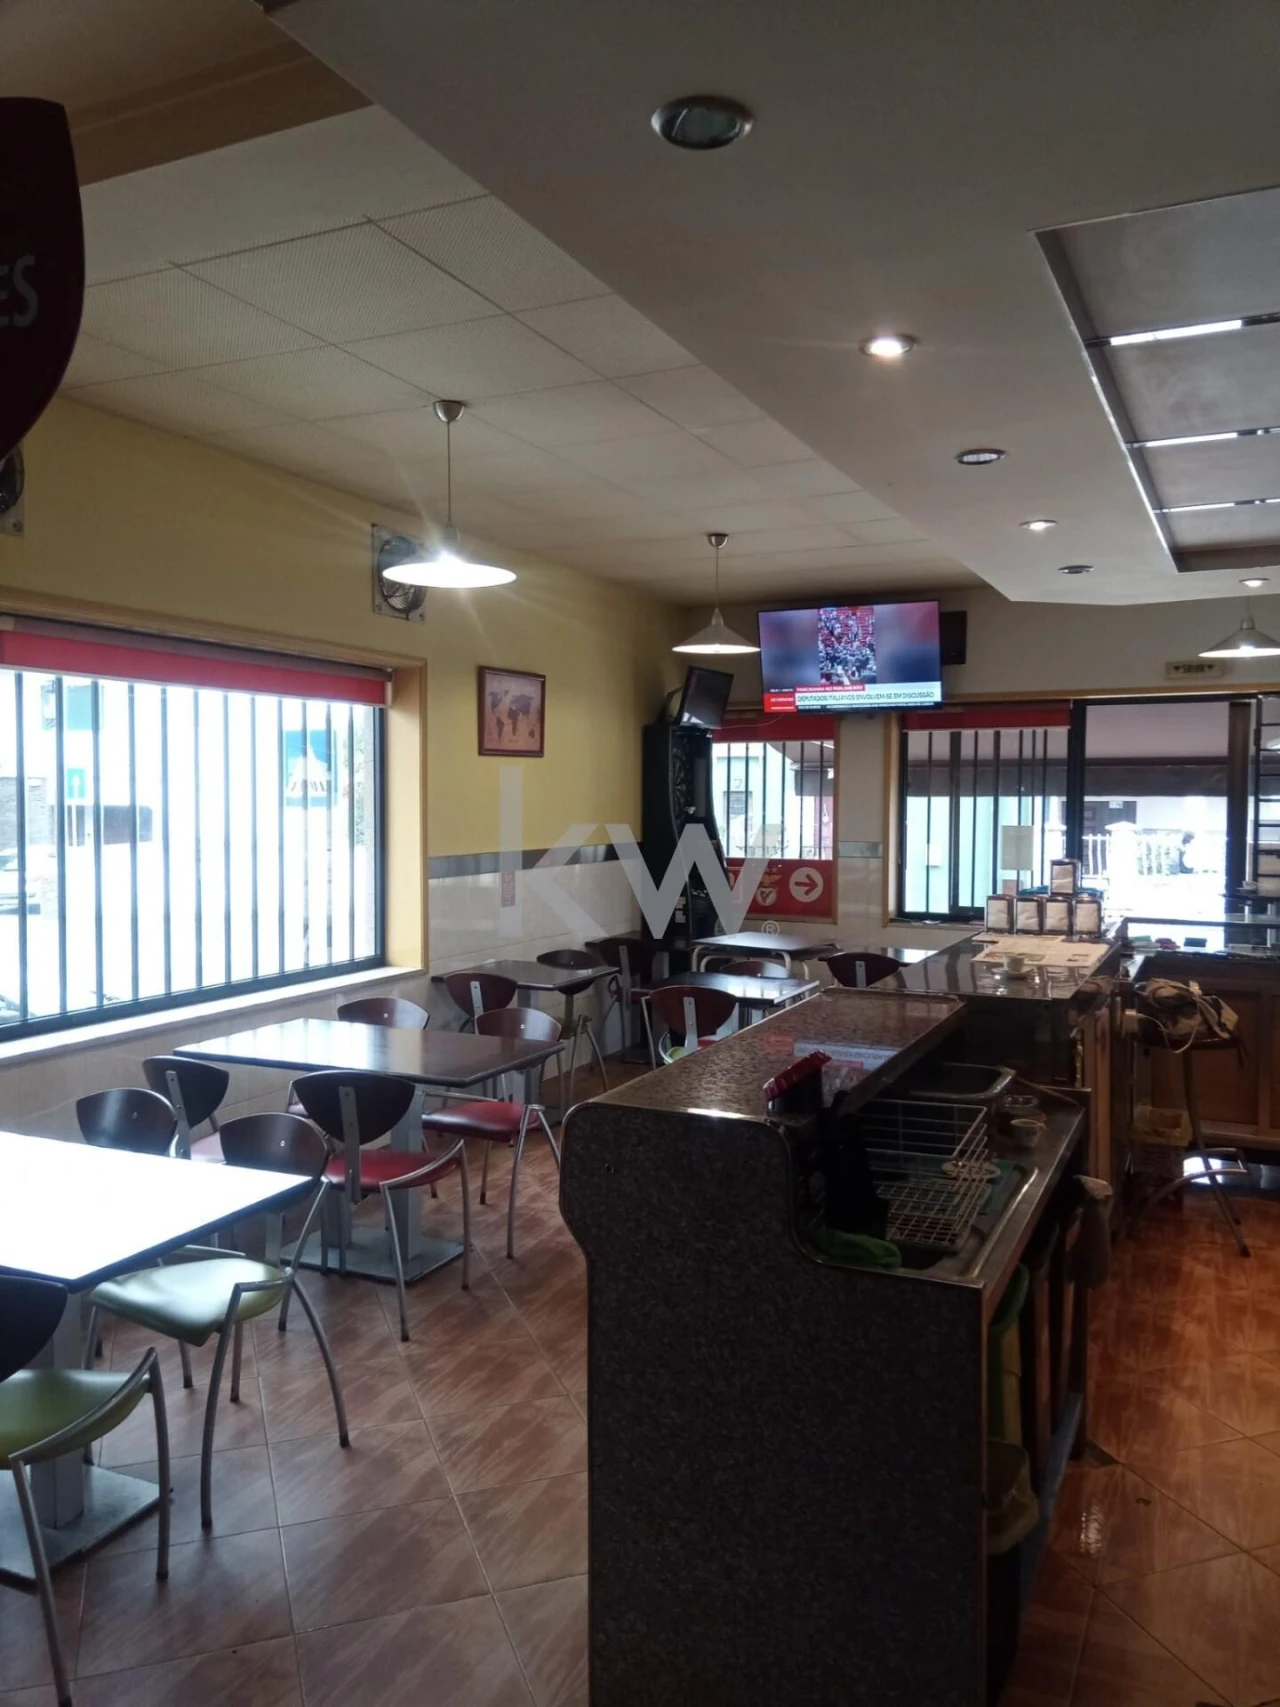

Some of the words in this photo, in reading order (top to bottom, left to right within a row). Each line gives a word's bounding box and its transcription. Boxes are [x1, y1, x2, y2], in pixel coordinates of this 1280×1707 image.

[797, 694, 828, 702] DEPUTADOS
[828, 693, 855, 701] ITALIANOS
[903, 690, 935, 699] DISCUSSÃO
